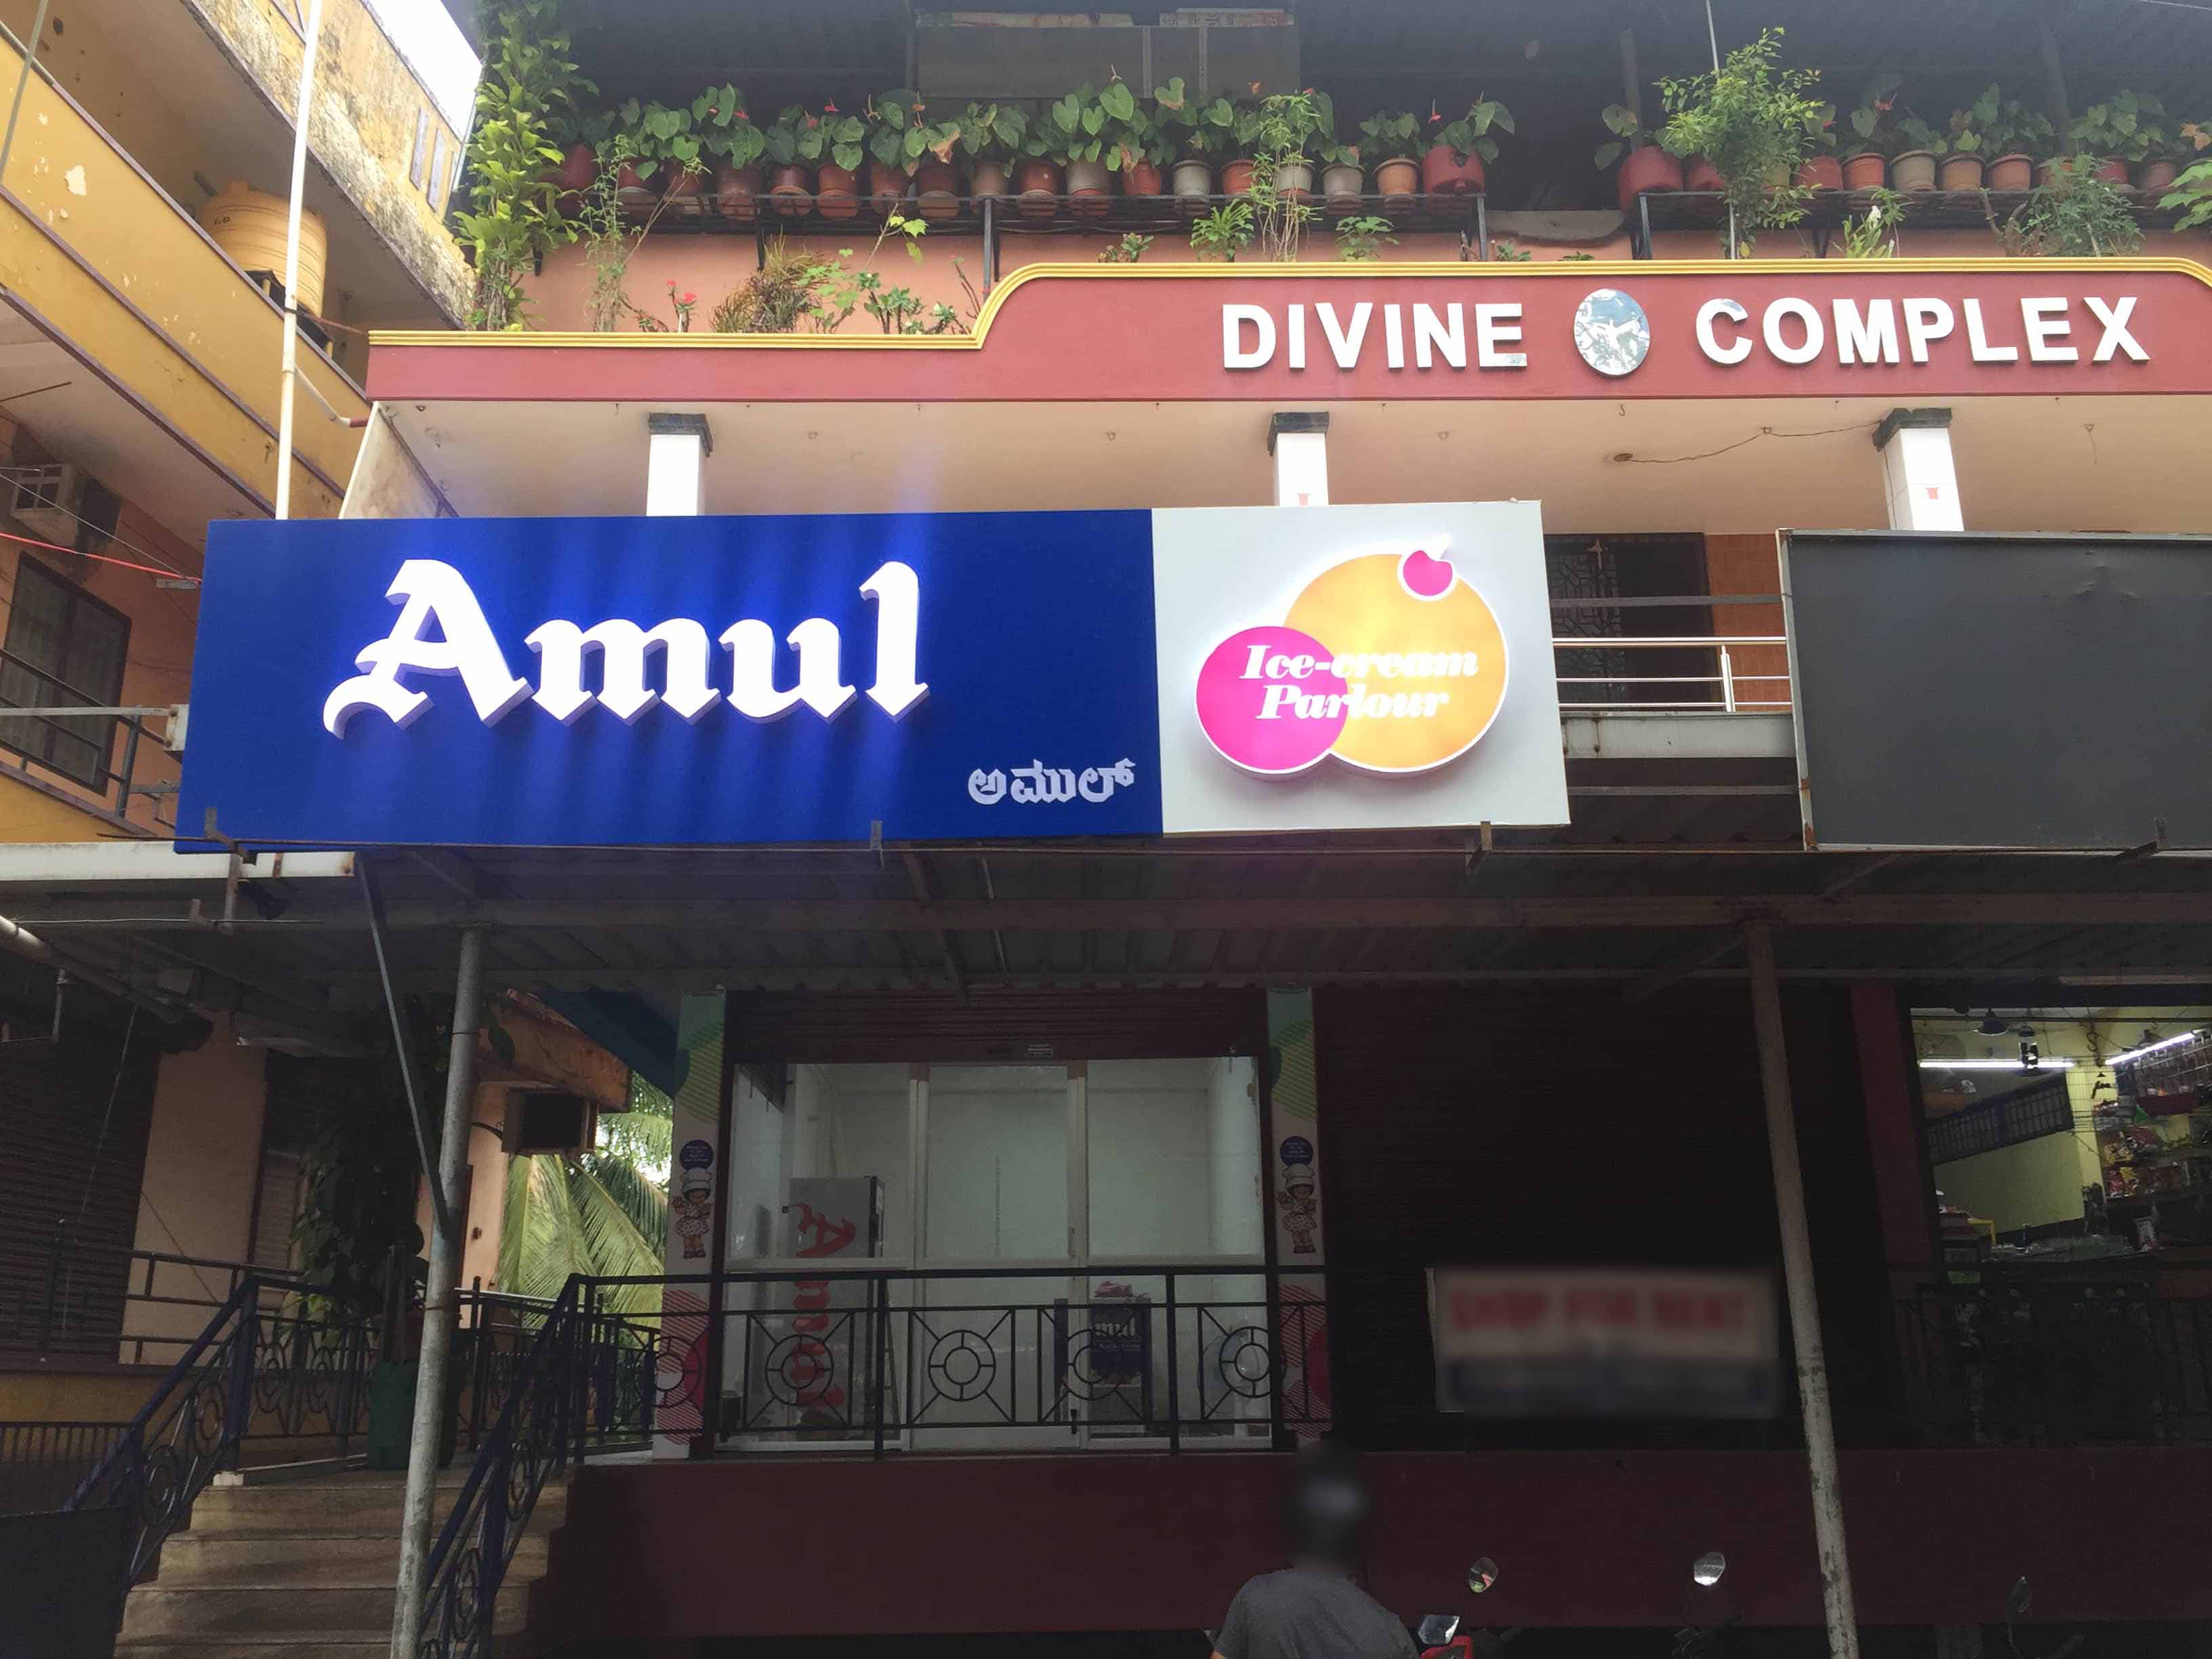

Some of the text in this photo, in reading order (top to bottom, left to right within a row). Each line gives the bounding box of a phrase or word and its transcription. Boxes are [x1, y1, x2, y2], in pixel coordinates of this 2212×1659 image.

[1223, 297, 2150, 370] DIVINE COMPLEX
[322, 558, 928, 739] Amul
[1240, 644, 1478, 681] Ice-cream
[1256, 684, 1450, 720] Parlour
[968, 758, 1136, 804] ಅಮುಲ್
[1094, 1317, 1136, 1337] mul
